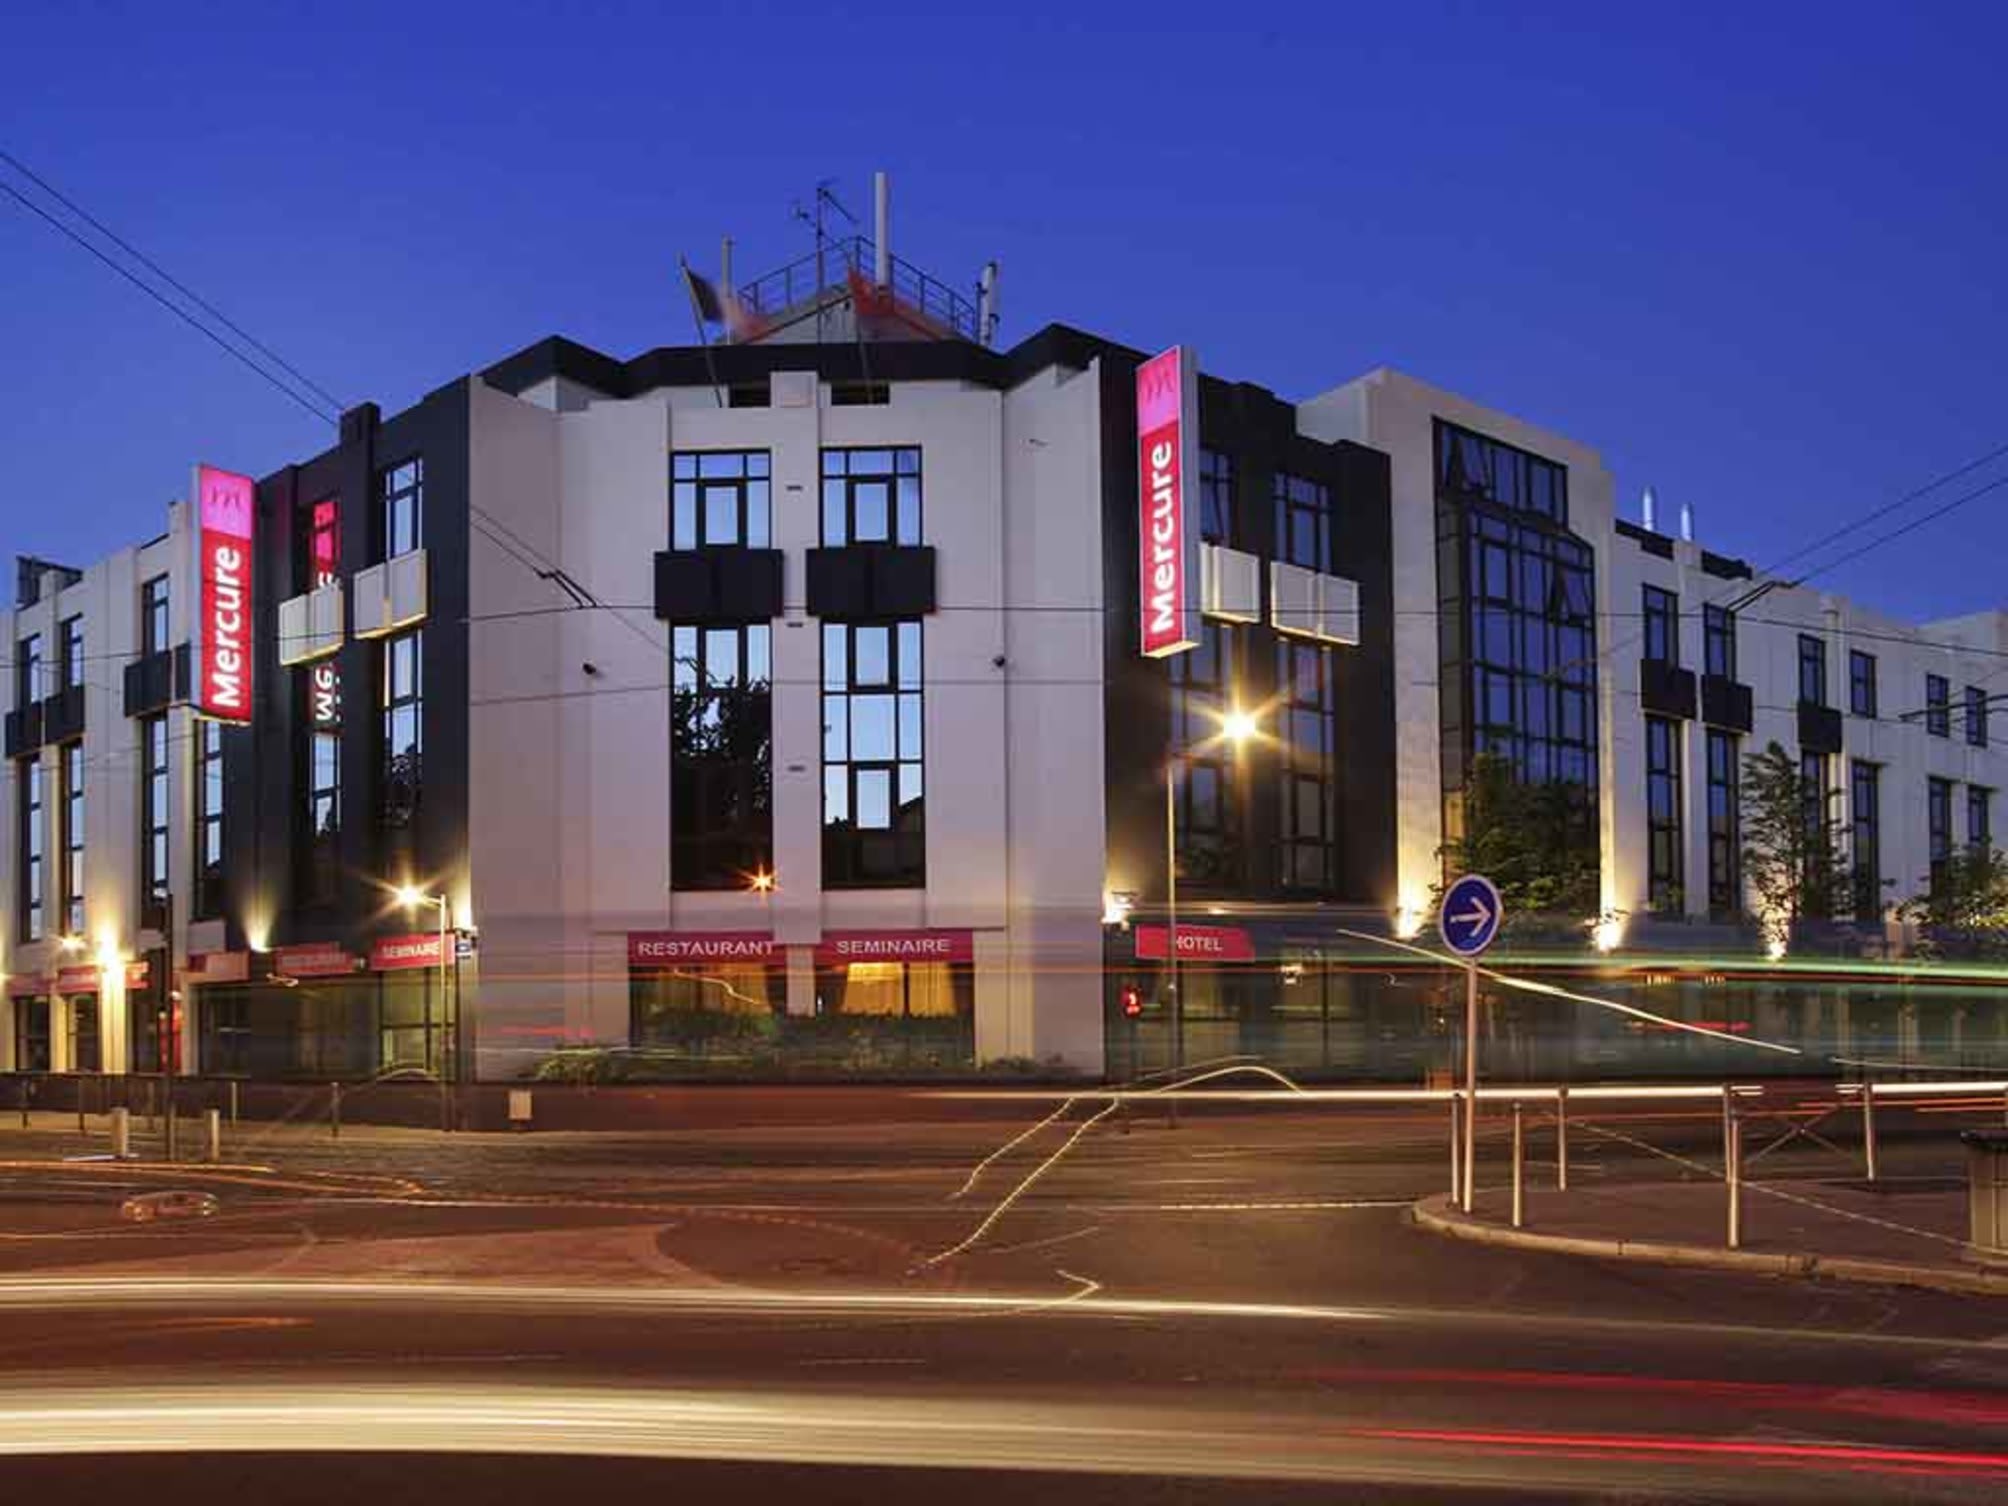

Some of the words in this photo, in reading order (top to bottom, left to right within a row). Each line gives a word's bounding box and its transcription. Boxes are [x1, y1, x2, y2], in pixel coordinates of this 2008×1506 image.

[1151, 441, 1174, 635] Mercure
[213, 546, 241, 708] Mercure
[637, 940, 774, 957] RESTAURANT
[836, 938, 952, 954] SEMINAIRE
